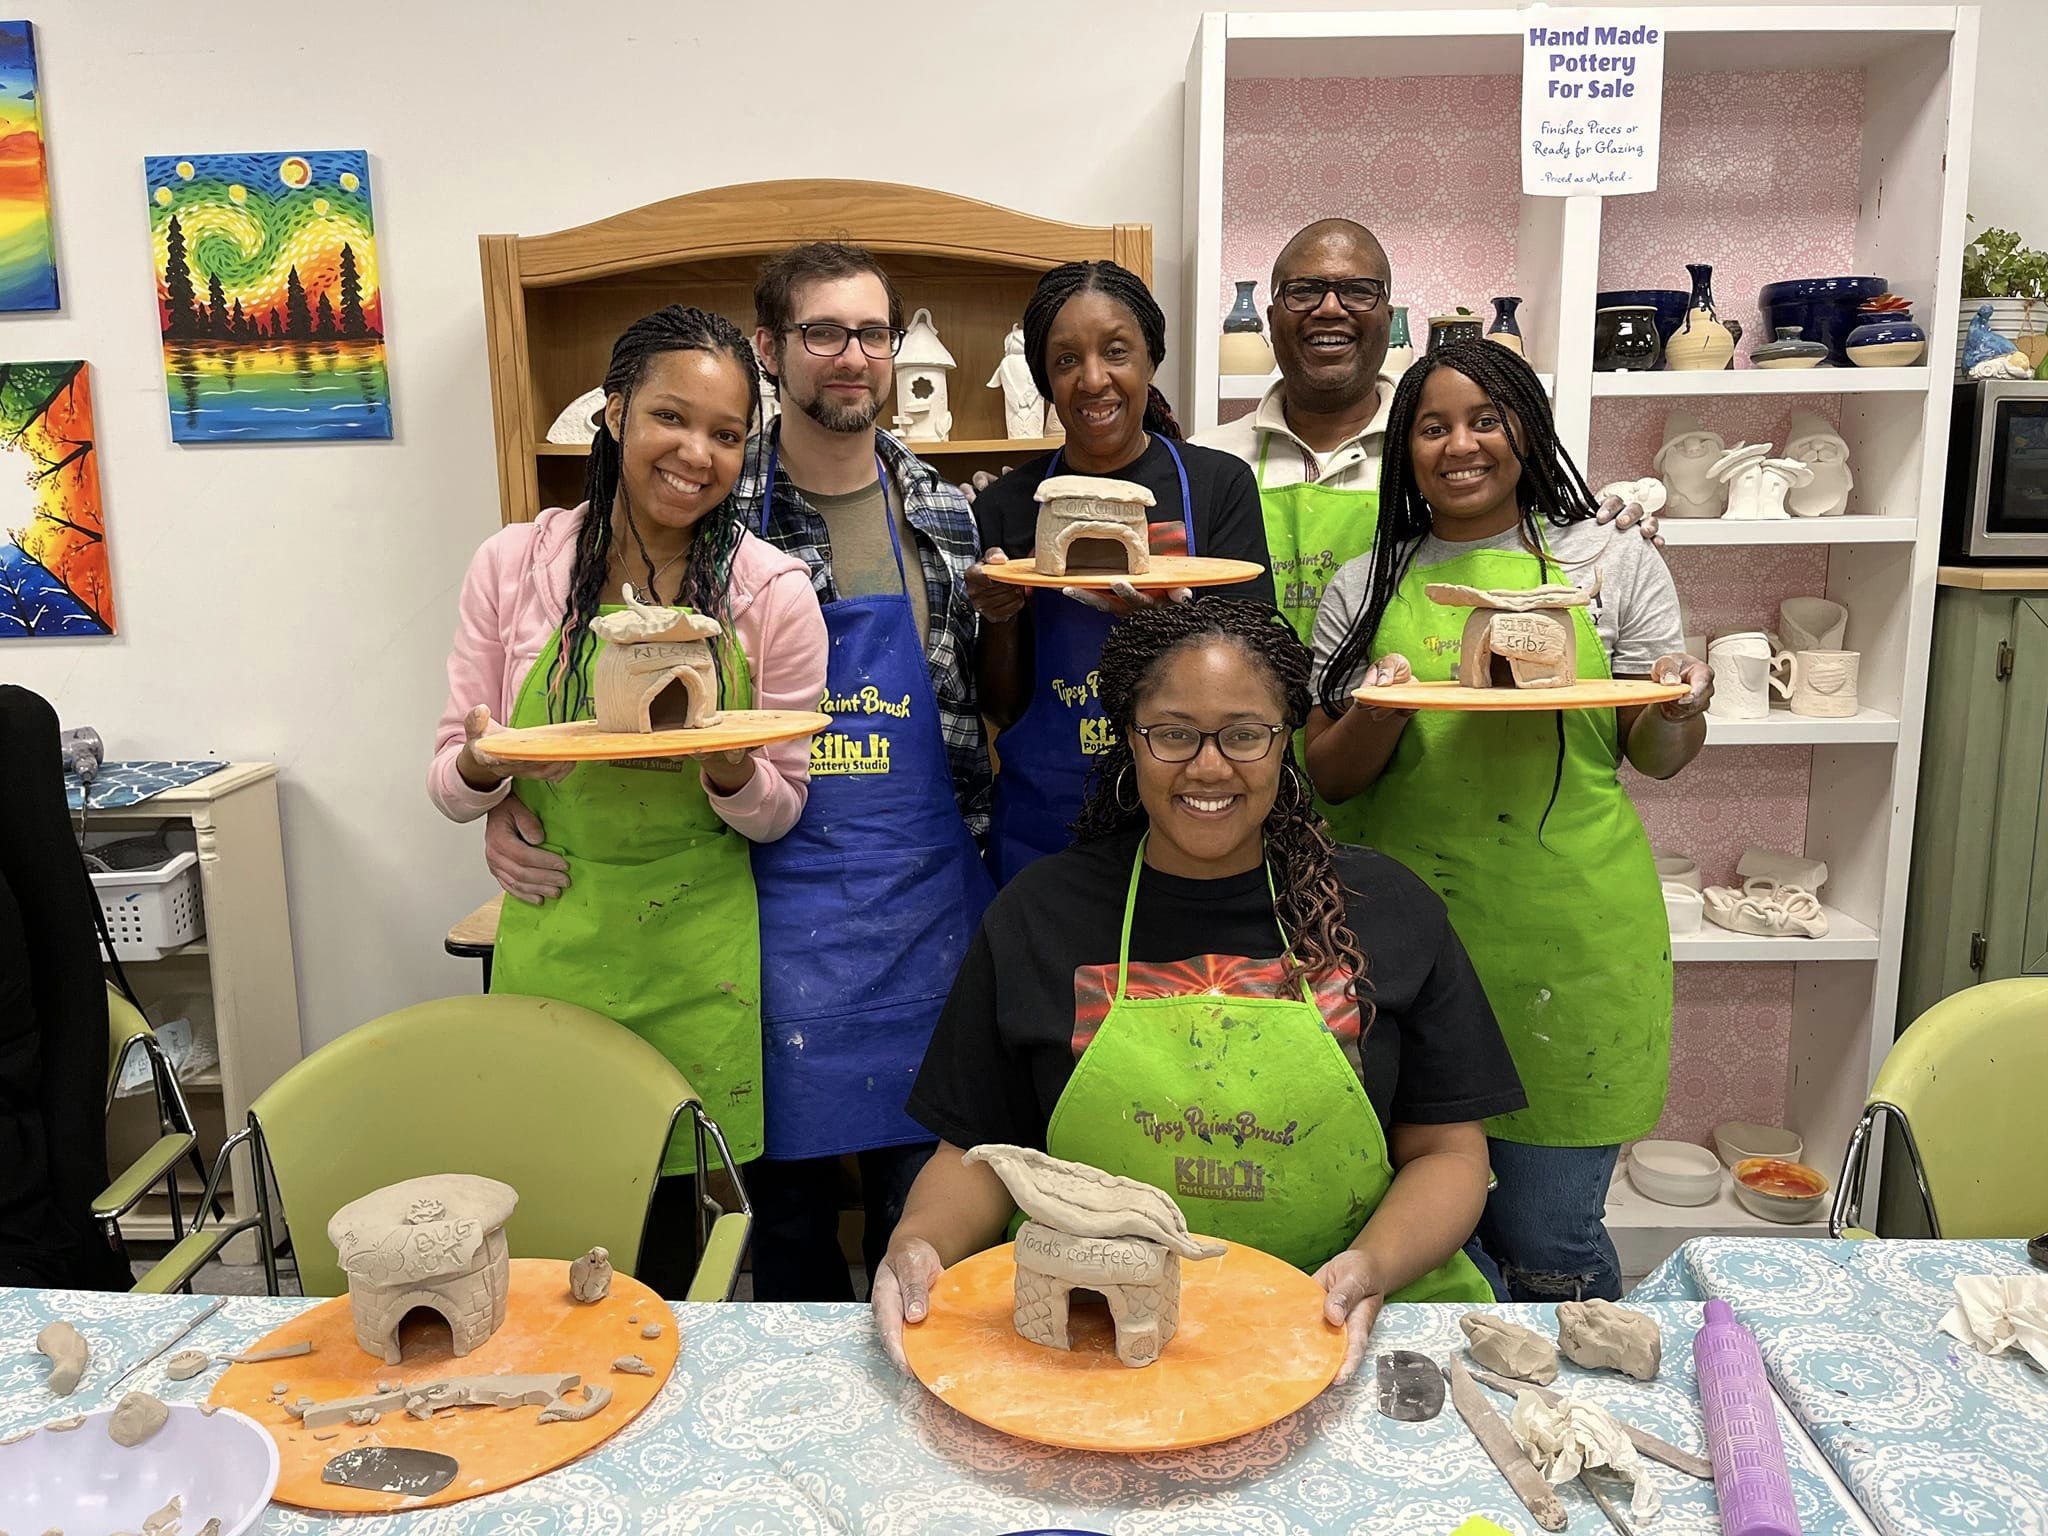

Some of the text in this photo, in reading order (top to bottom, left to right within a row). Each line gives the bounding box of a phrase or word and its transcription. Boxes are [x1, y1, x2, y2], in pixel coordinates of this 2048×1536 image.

[1530, 25, 1658, 46] Hand Made
[1550, 54, 1635, 76] Pottery
[1549, 79, 1635, 98] For Sale
[1541, 120, 1638, 134] Finishes Pieces or
[1532, 139, 1644, 159] Ready for Glazing
[860, 686, 911, 718] Brush
[1052, 679, 1088, 708] Tipsy
[869, 734, 890, 758] It
[809, 760, 888, 772] Pottery Studio
[1134, 1106, 1298, 1146] Tipsy Paint Brush
[1179, 1184, 1263, 1199] Pottery Studio
[414, 1219, 477, 1253] BUG
[1067, 1243, 1134, 1265] coffee
